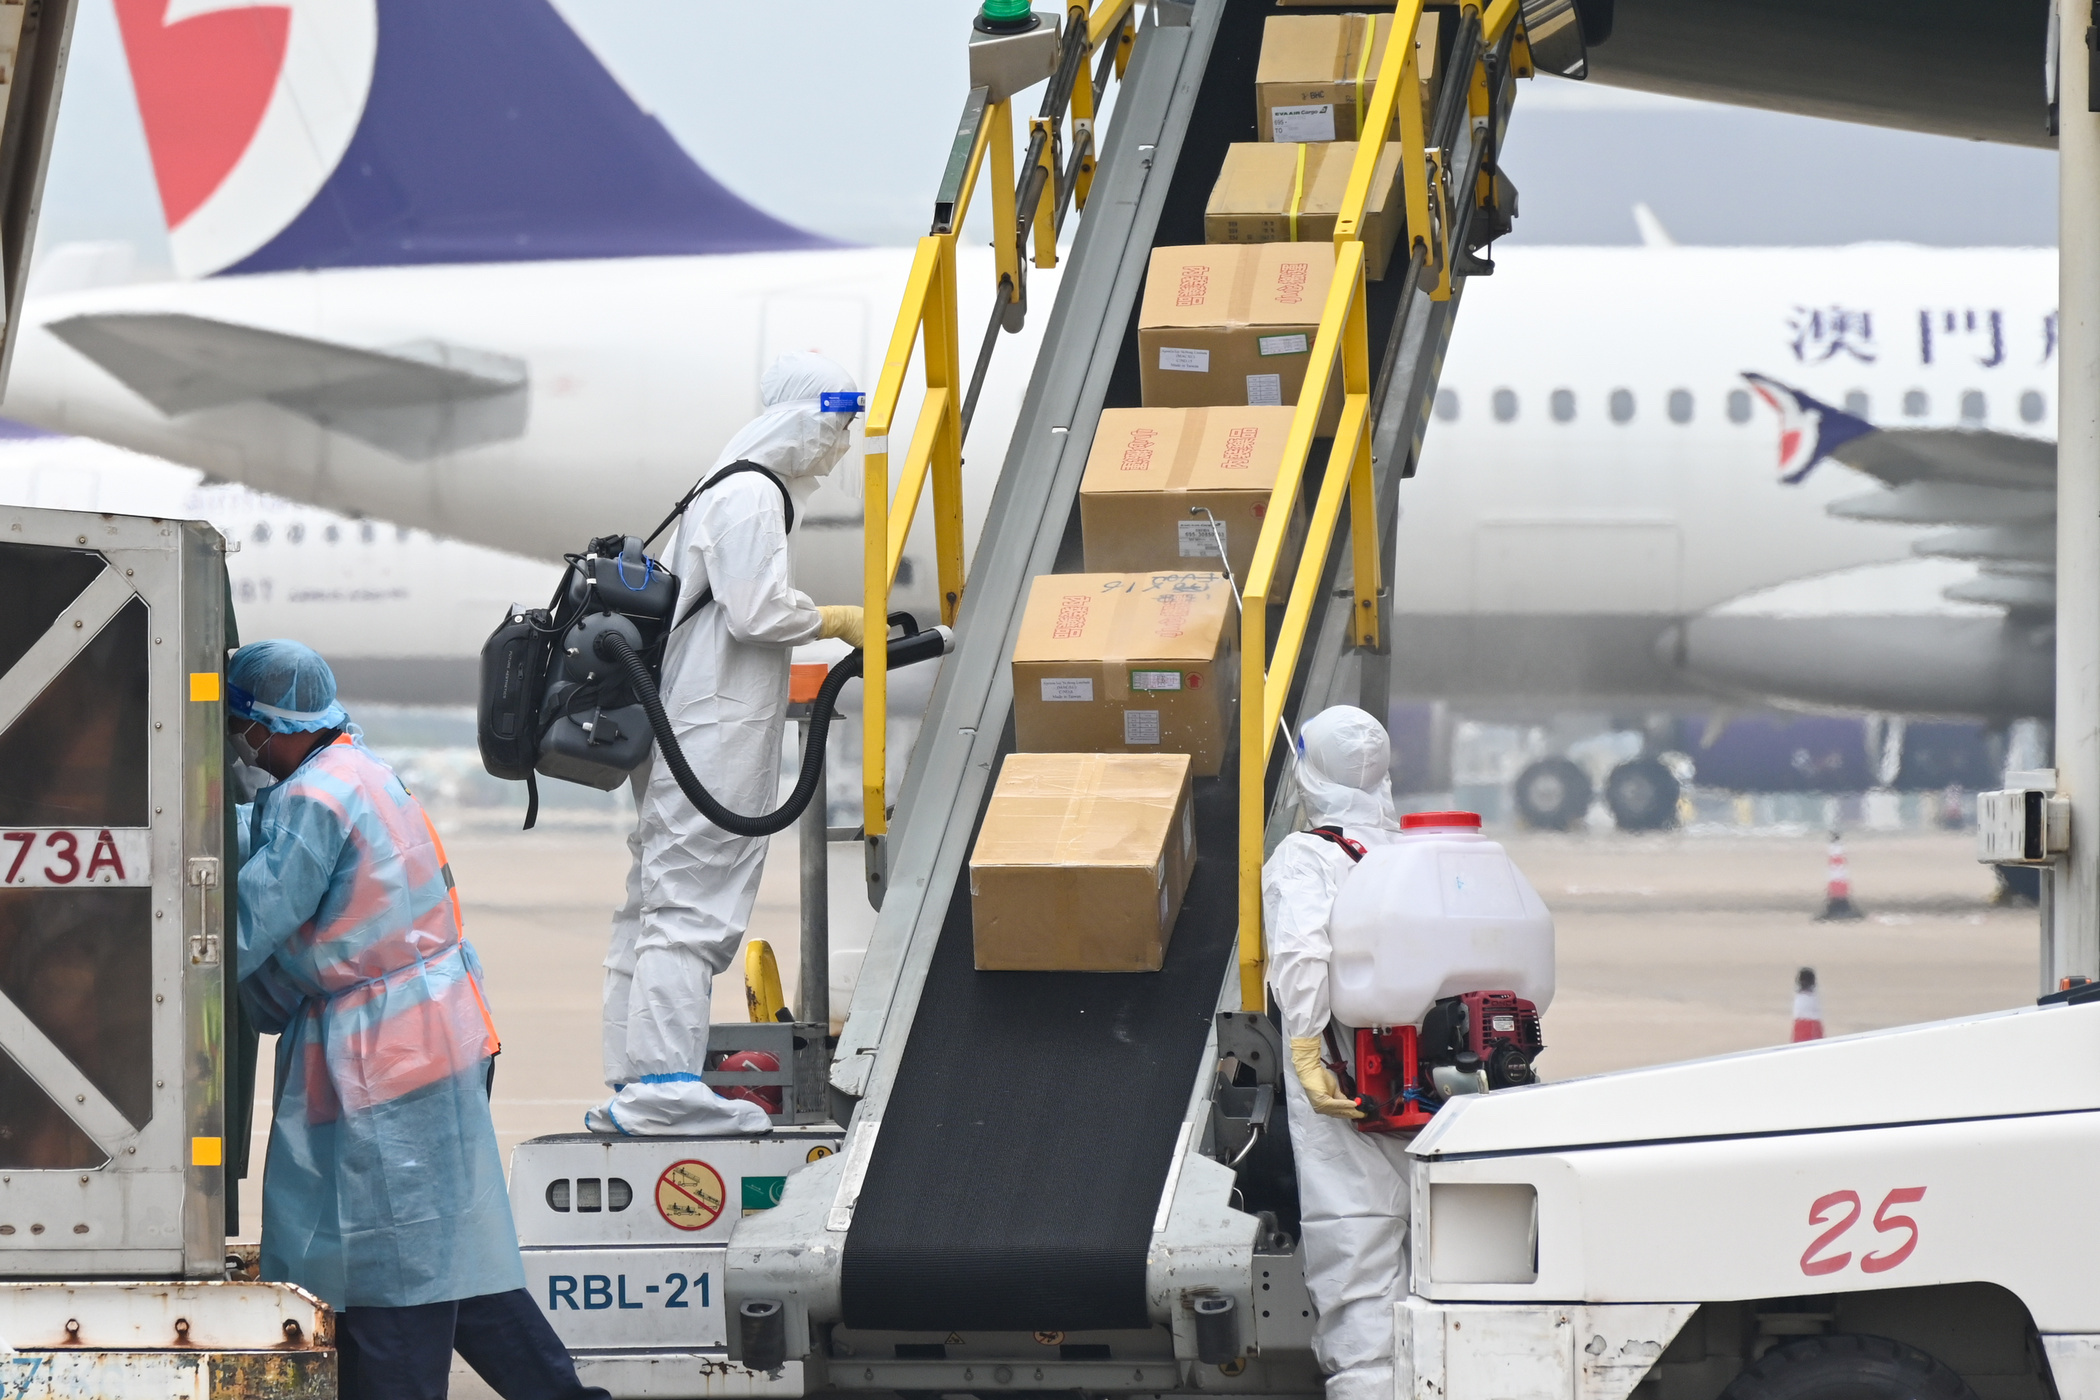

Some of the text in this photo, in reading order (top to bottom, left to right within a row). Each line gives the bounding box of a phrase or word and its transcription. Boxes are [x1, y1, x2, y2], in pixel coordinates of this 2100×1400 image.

[4, 830, 126, 884] 73A
[1800, 1186, 1928, 1276] 25
[549, 1272, 710, 1311] RBL-21
